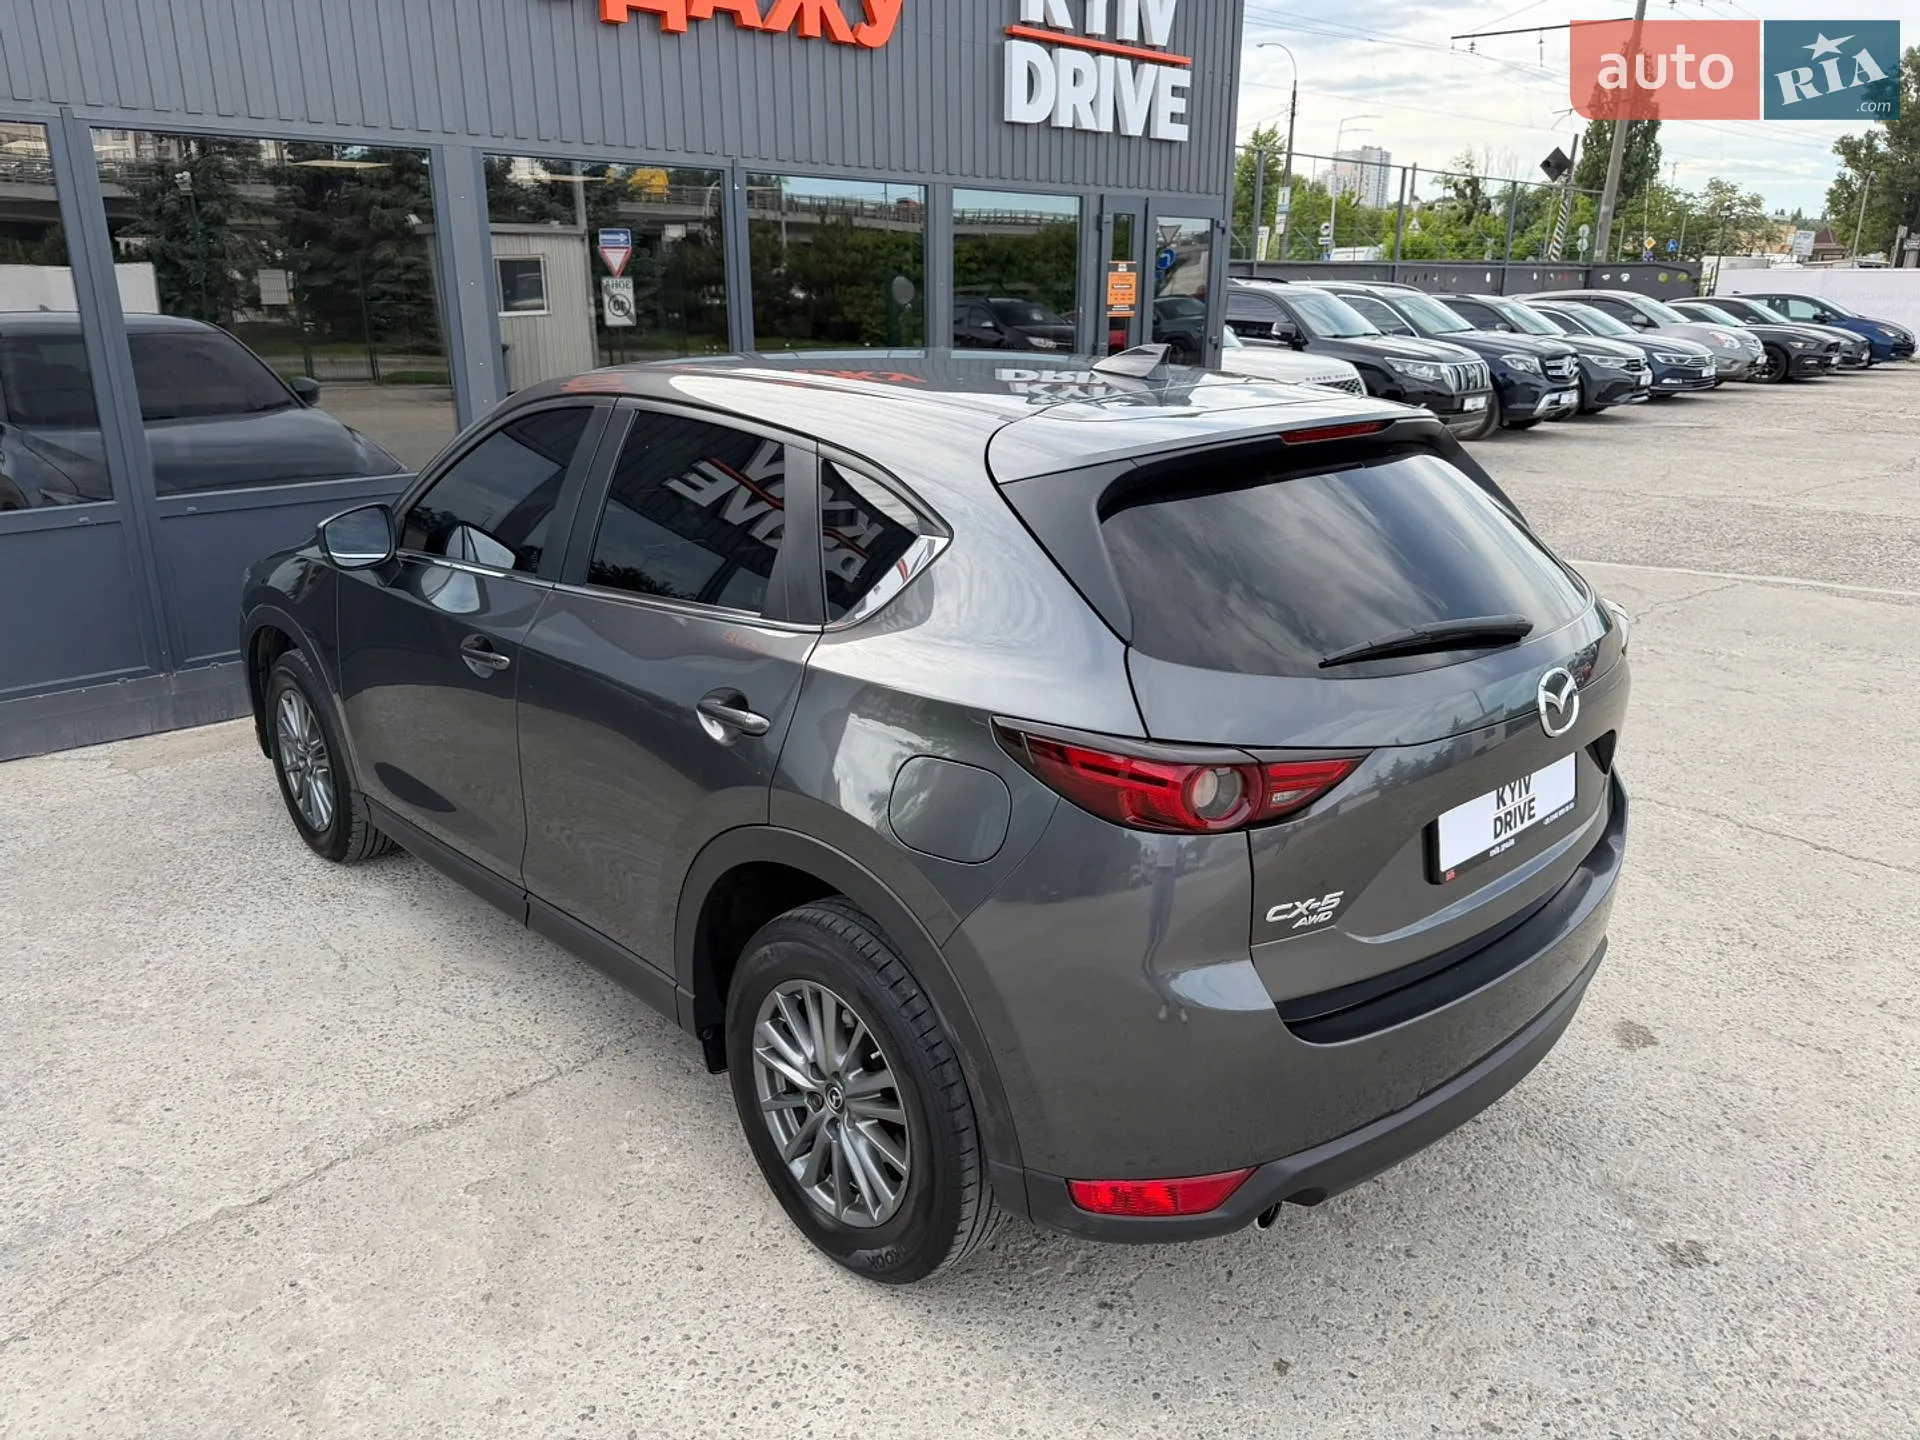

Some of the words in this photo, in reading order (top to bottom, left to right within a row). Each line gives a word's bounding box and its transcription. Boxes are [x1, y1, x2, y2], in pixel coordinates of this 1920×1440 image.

[1004, 39, 1191, 141] DRIVE
[1496, 774, 1531, 810] KYIV
[1493, 797, 1536, 840] DRIVE
[1265, 890, 1344, 922] CX-5
[1292, 910, 1333, 929] AWD
